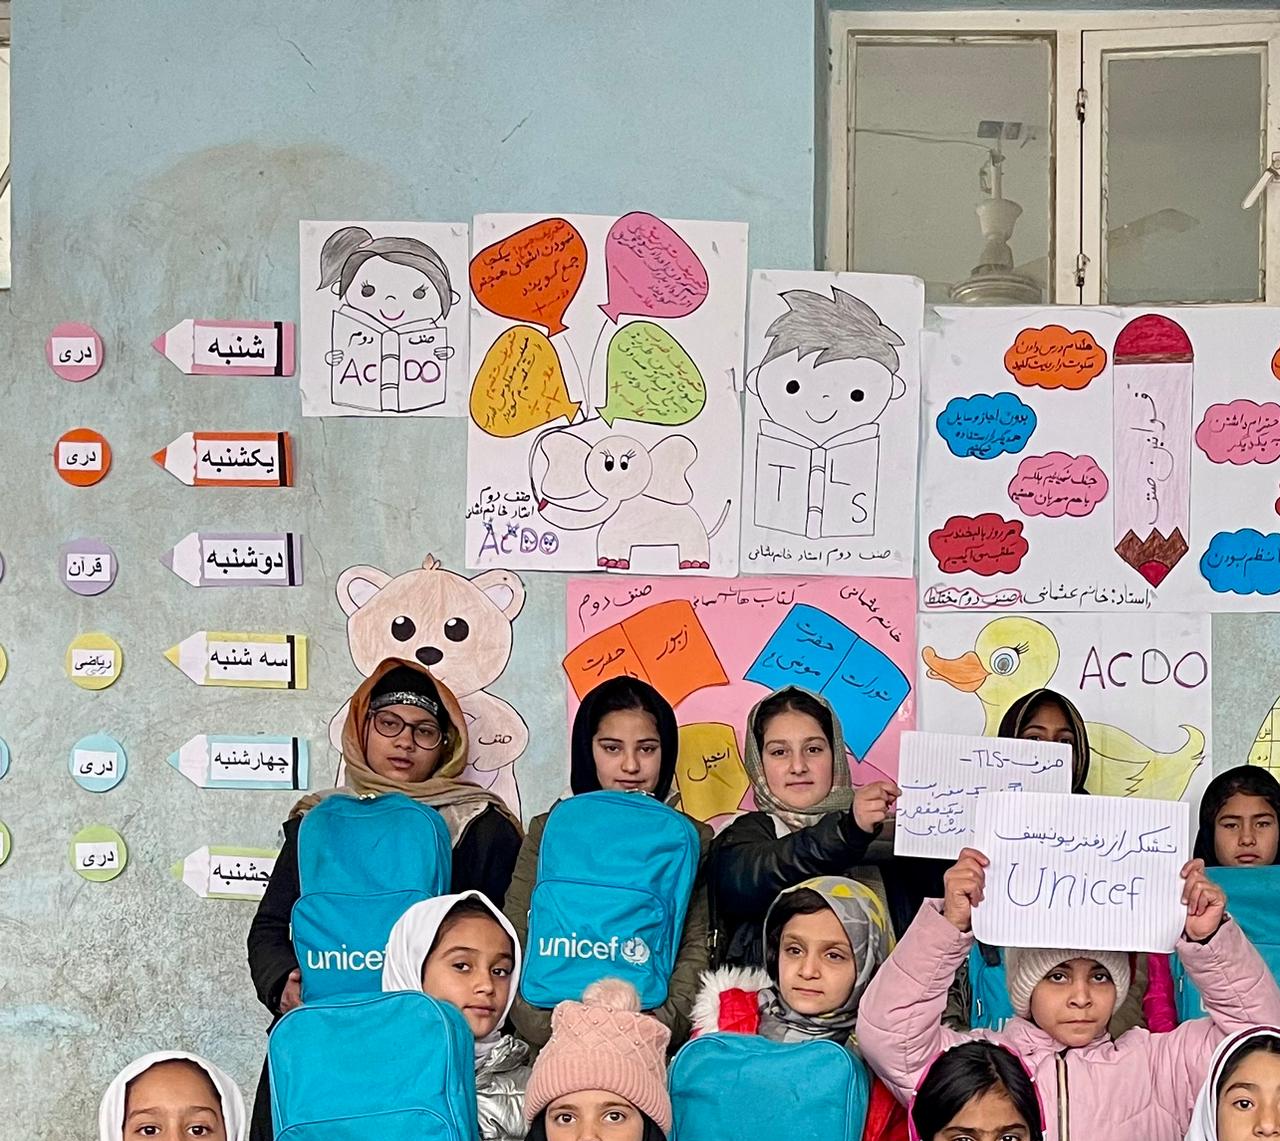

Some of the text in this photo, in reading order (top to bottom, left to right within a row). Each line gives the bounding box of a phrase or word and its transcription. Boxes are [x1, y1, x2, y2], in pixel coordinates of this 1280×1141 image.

[207, 333, 265, 365] شنبه
[408, 332, 435, 345] صنف
[58, 343, 93, 363] دری
[65, 450, 97, 467] دری
[201, 447, 275, 474] یکشنبه
[859, 549, 891, 560] صنف
[68, 556, 102, 577] قرآن
[578, 584, 653, 633] صنف دوم
[74, 653, 112, 672] ریاضی
[210, 647, 289, 671] سه شنبه
[1079, 645, 1208, 690] ACDO
[79, 759, 114, 776] دری
[213, 752, 289, 775] چهارشنبه
[1099, 829, 1127, 858] از
[1112, 825, 1178, 863] تشکر
[82, 849, 115, 868] دری
[1006, 862, 1146, 911] Unicef
[538, 931, 619, 962] unicef
